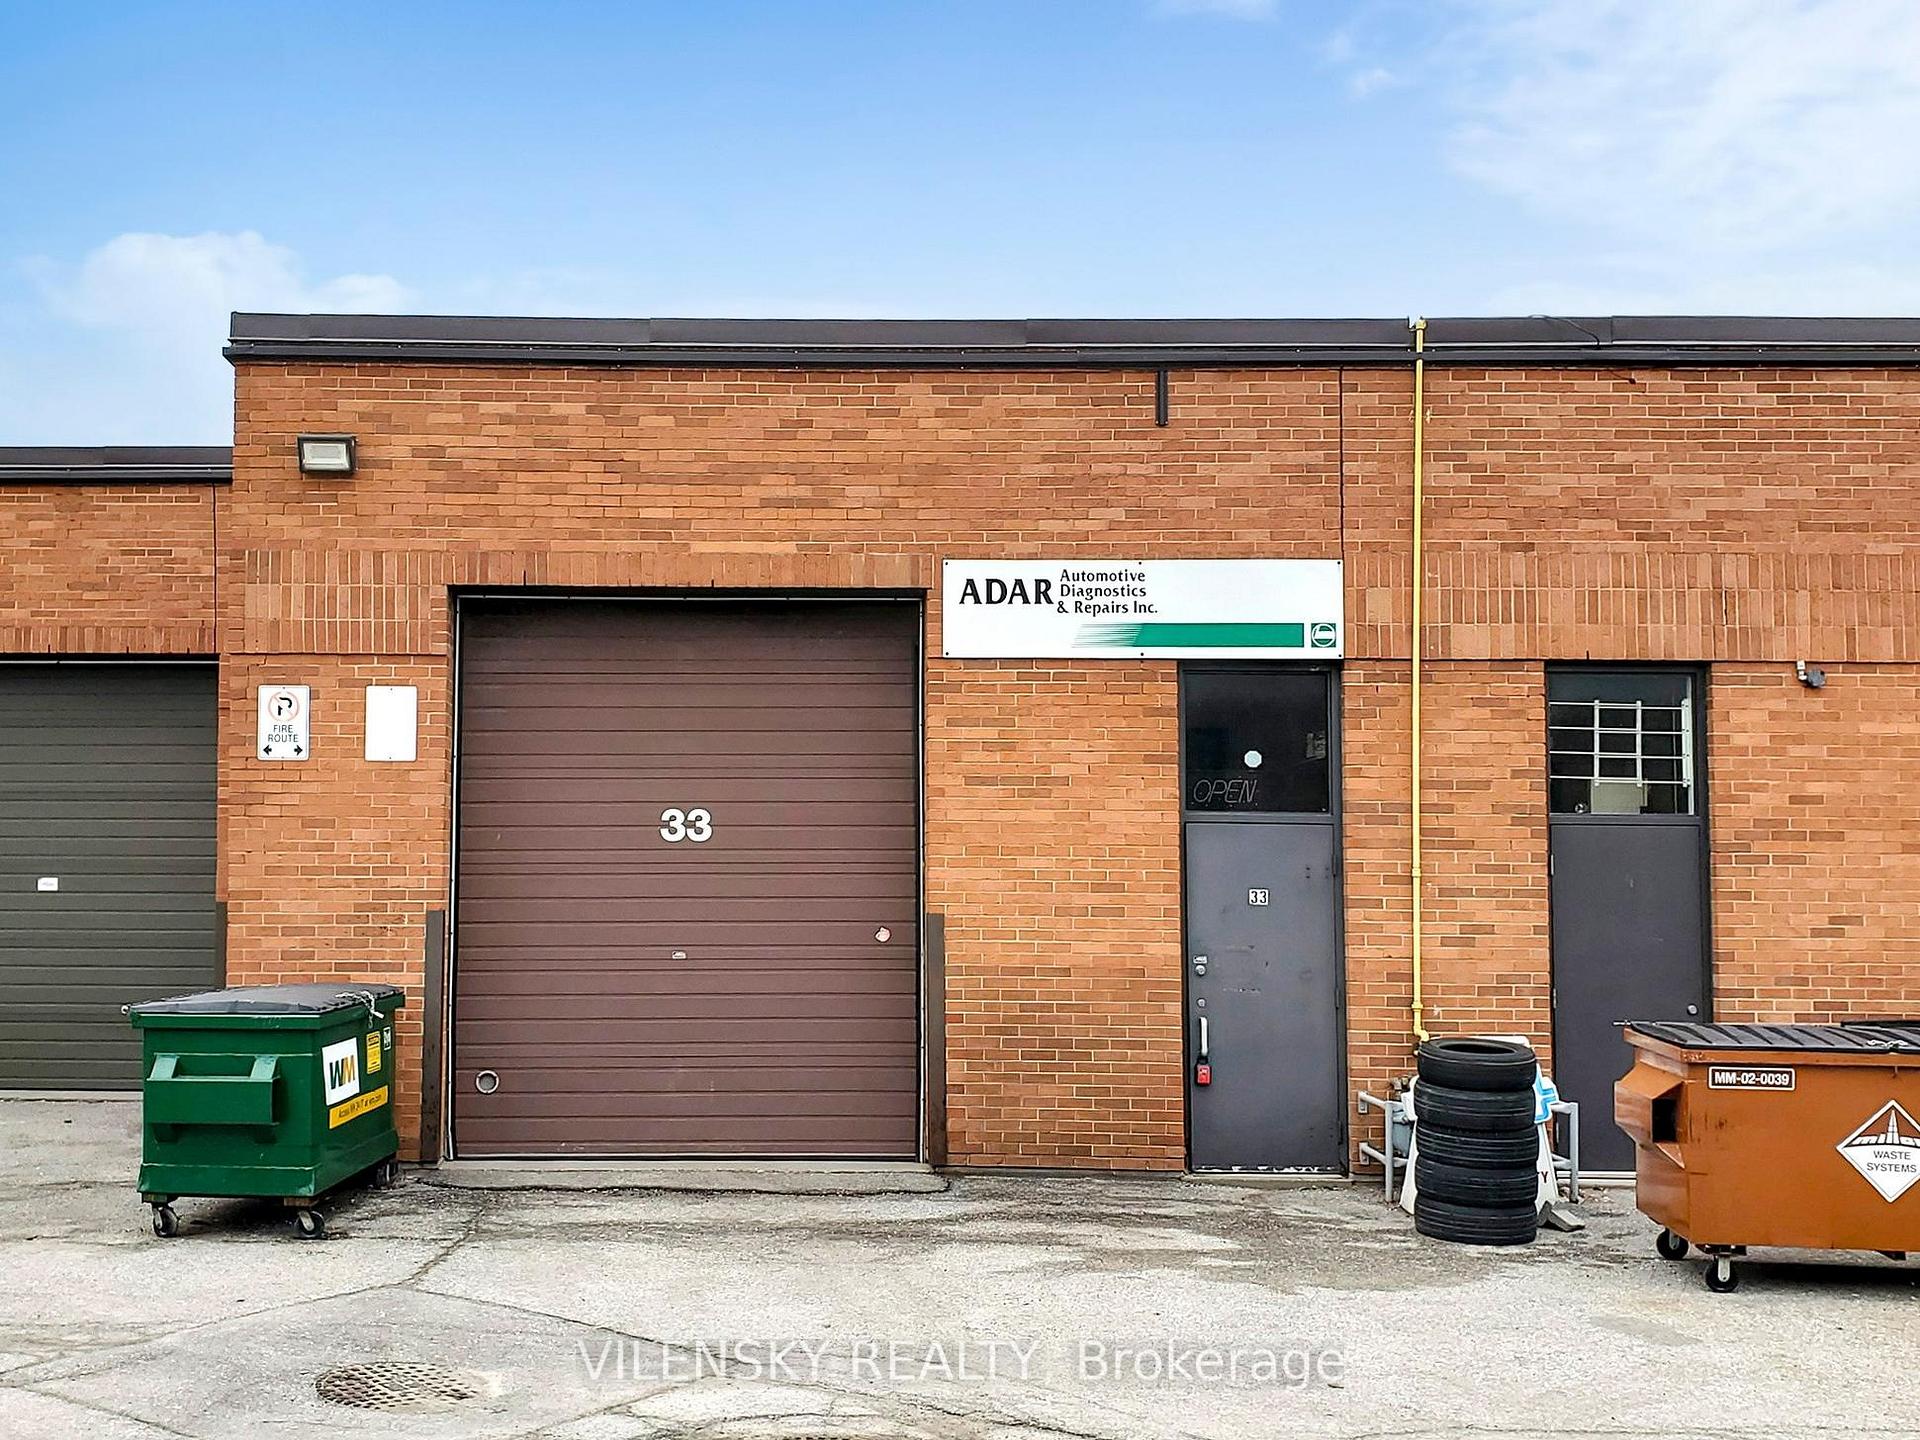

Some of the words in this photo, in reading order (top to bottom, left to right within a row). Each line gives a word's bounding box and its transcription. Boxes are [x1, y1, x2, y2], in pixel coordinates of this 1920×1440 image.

[1060, 569, 1146, 582] Automotive
[959, 578, 1054, 605] ADAR
[1060, 584, 1147, 600] Diagnostics
[1057, 601, 1069, 613] &
[1074, 601, 1129, 617] Repairs
[1133, 601, 1158, 613] Inc.
[273, 724, 294, 734] FIRE
[267, 734, 299, 743] ROUTE
[1193, 779, 1257, 803] OPEN
[658, 807, 713, 843] 33
[1250, 890, 1267, 904] 33
[329, 1054, 356, 1090] WM
[1714, 1072, 1790, 1085] MM-02-0039
[1873, 1151, 1912, 1160] WASTE
[1866, 1162, 1917, 1173] SYSTEMS
